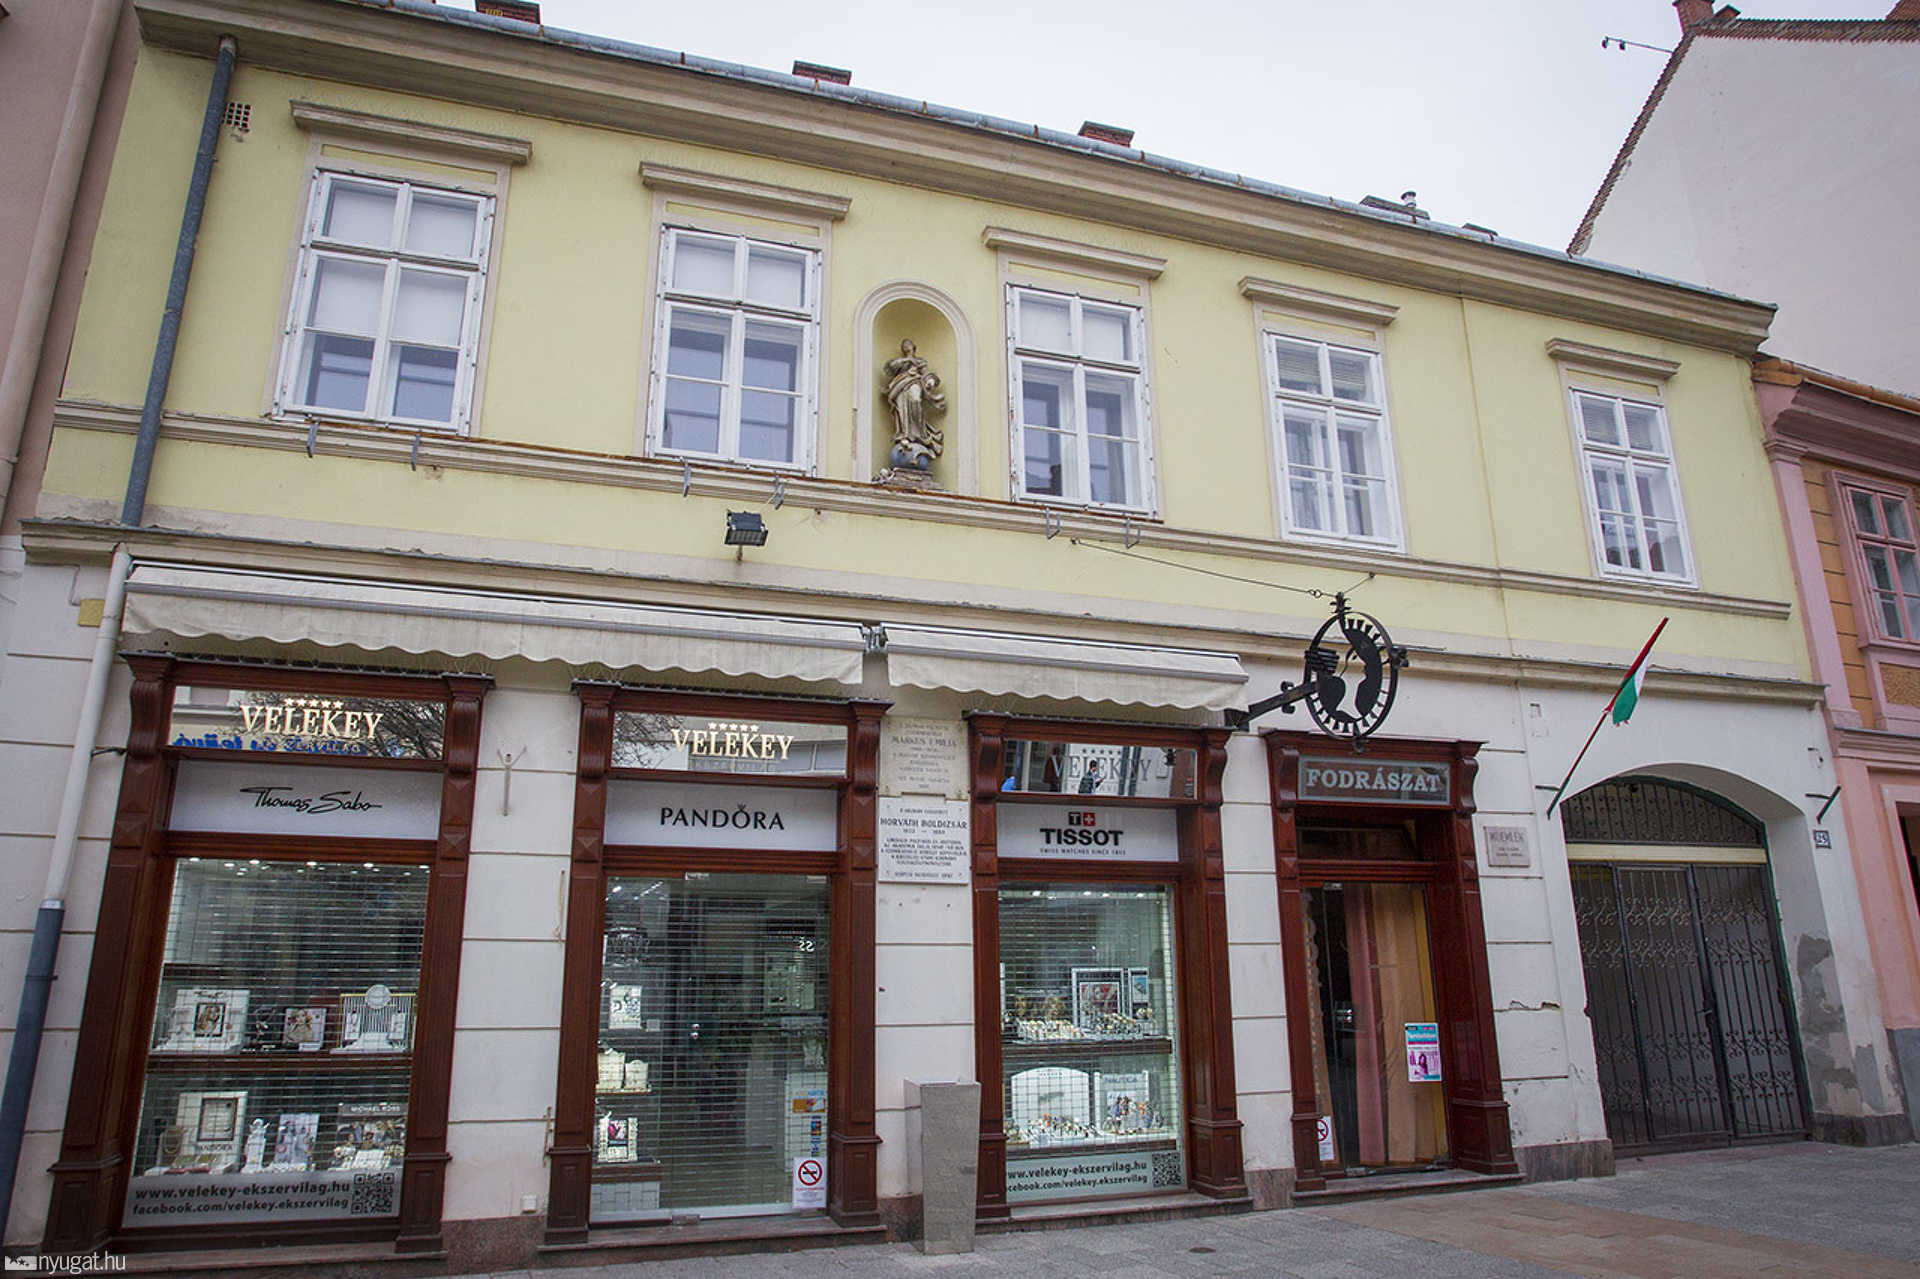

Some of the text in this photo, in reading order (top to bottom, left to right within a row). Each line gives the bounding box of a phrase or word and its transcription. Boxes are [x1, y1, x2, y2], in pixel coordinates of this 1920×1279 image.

[240, 704, 384, 739] VELEKEY
[671, 728, 794, 760] VELEKEY
[1306, 767, 1440, 792] FODRÁSZAT
[239, 786, 382, 815] Thomas Sabo
[1040, 828, 1124, 846] TISSOT
[1007, 1161, 1148, 1179] ww.velekey-ekszervilag.hu
[135, 1181, 350, 1199] www.velekey-ekszervilag.hu
[1007, 1176, 1148, 1192] cebook.com/velekey.ekszervilag
[132, 1197, 349, 1215] facebook.com/velekey.ekszervilag
